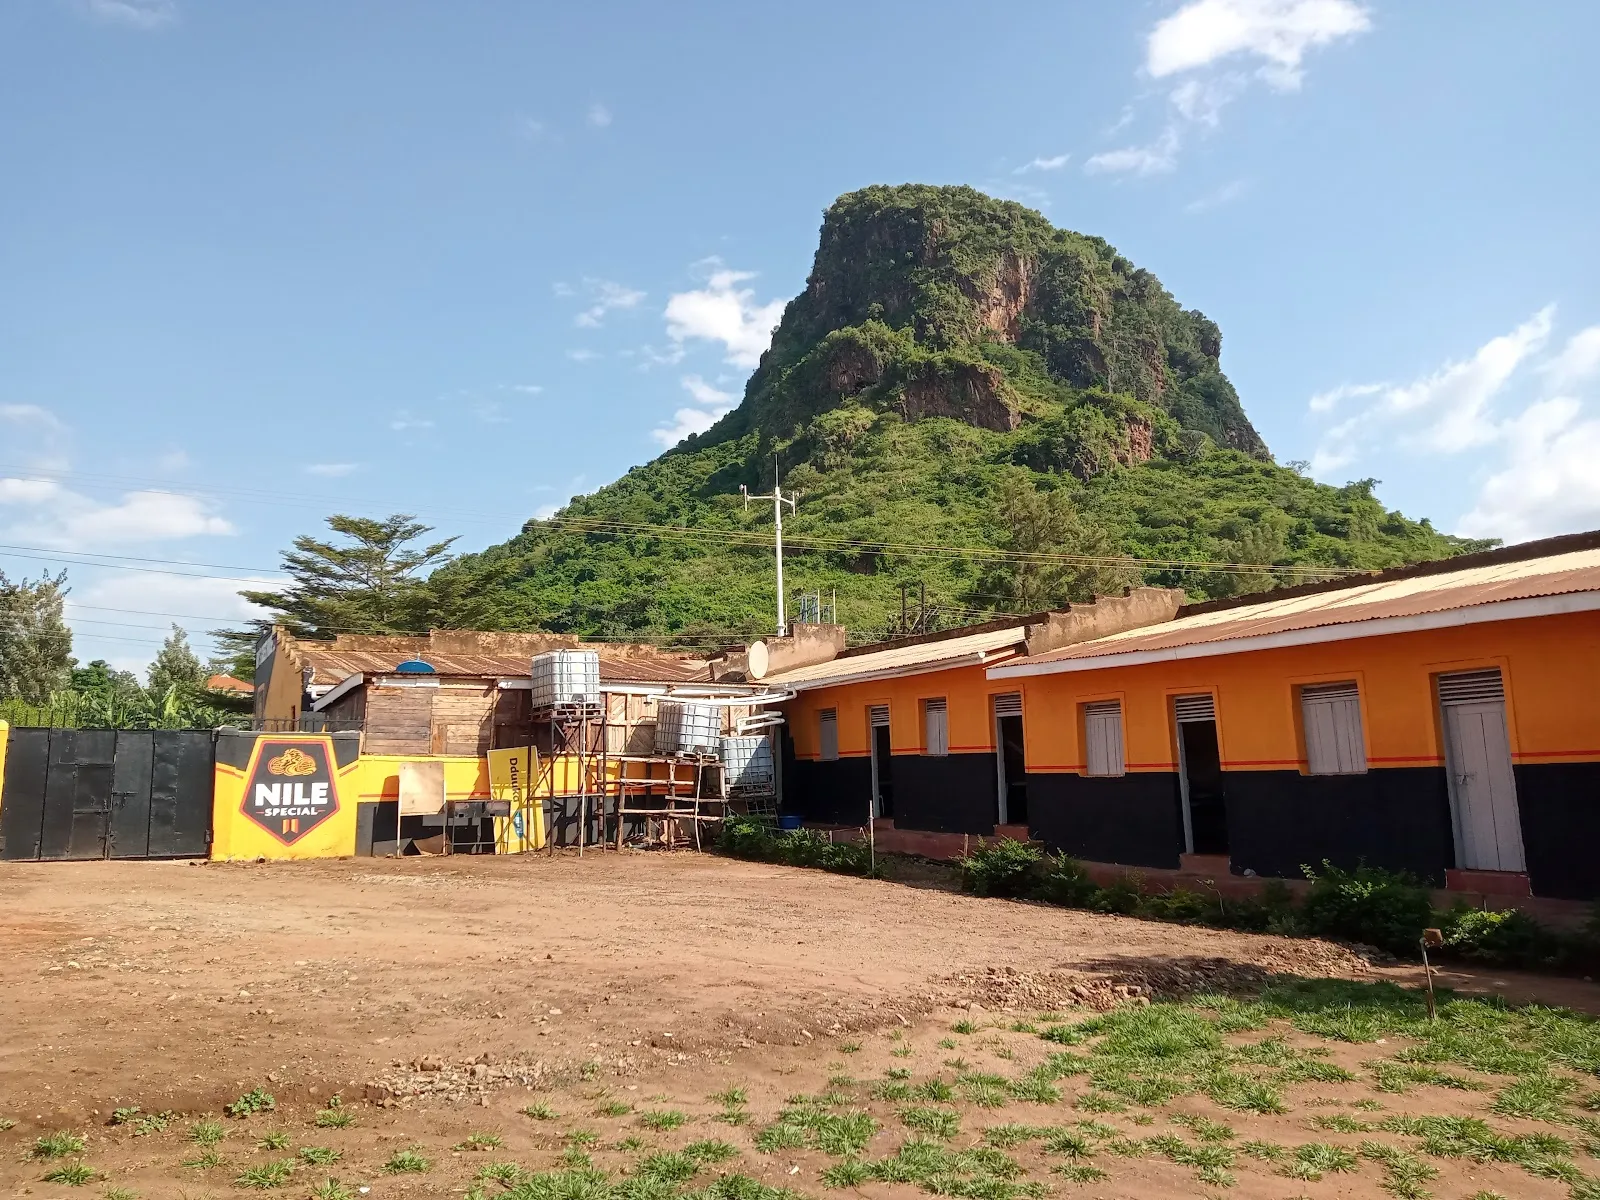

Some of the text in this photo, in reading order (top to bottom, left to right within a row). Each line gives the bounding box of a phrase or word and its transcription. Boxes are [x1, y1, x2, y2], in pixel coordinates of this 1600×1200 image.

[509, 757, 521, 803] Dduuka
[255, 782, 329, 806] NILE
[264, 806, 319, 817] SPECIAL
